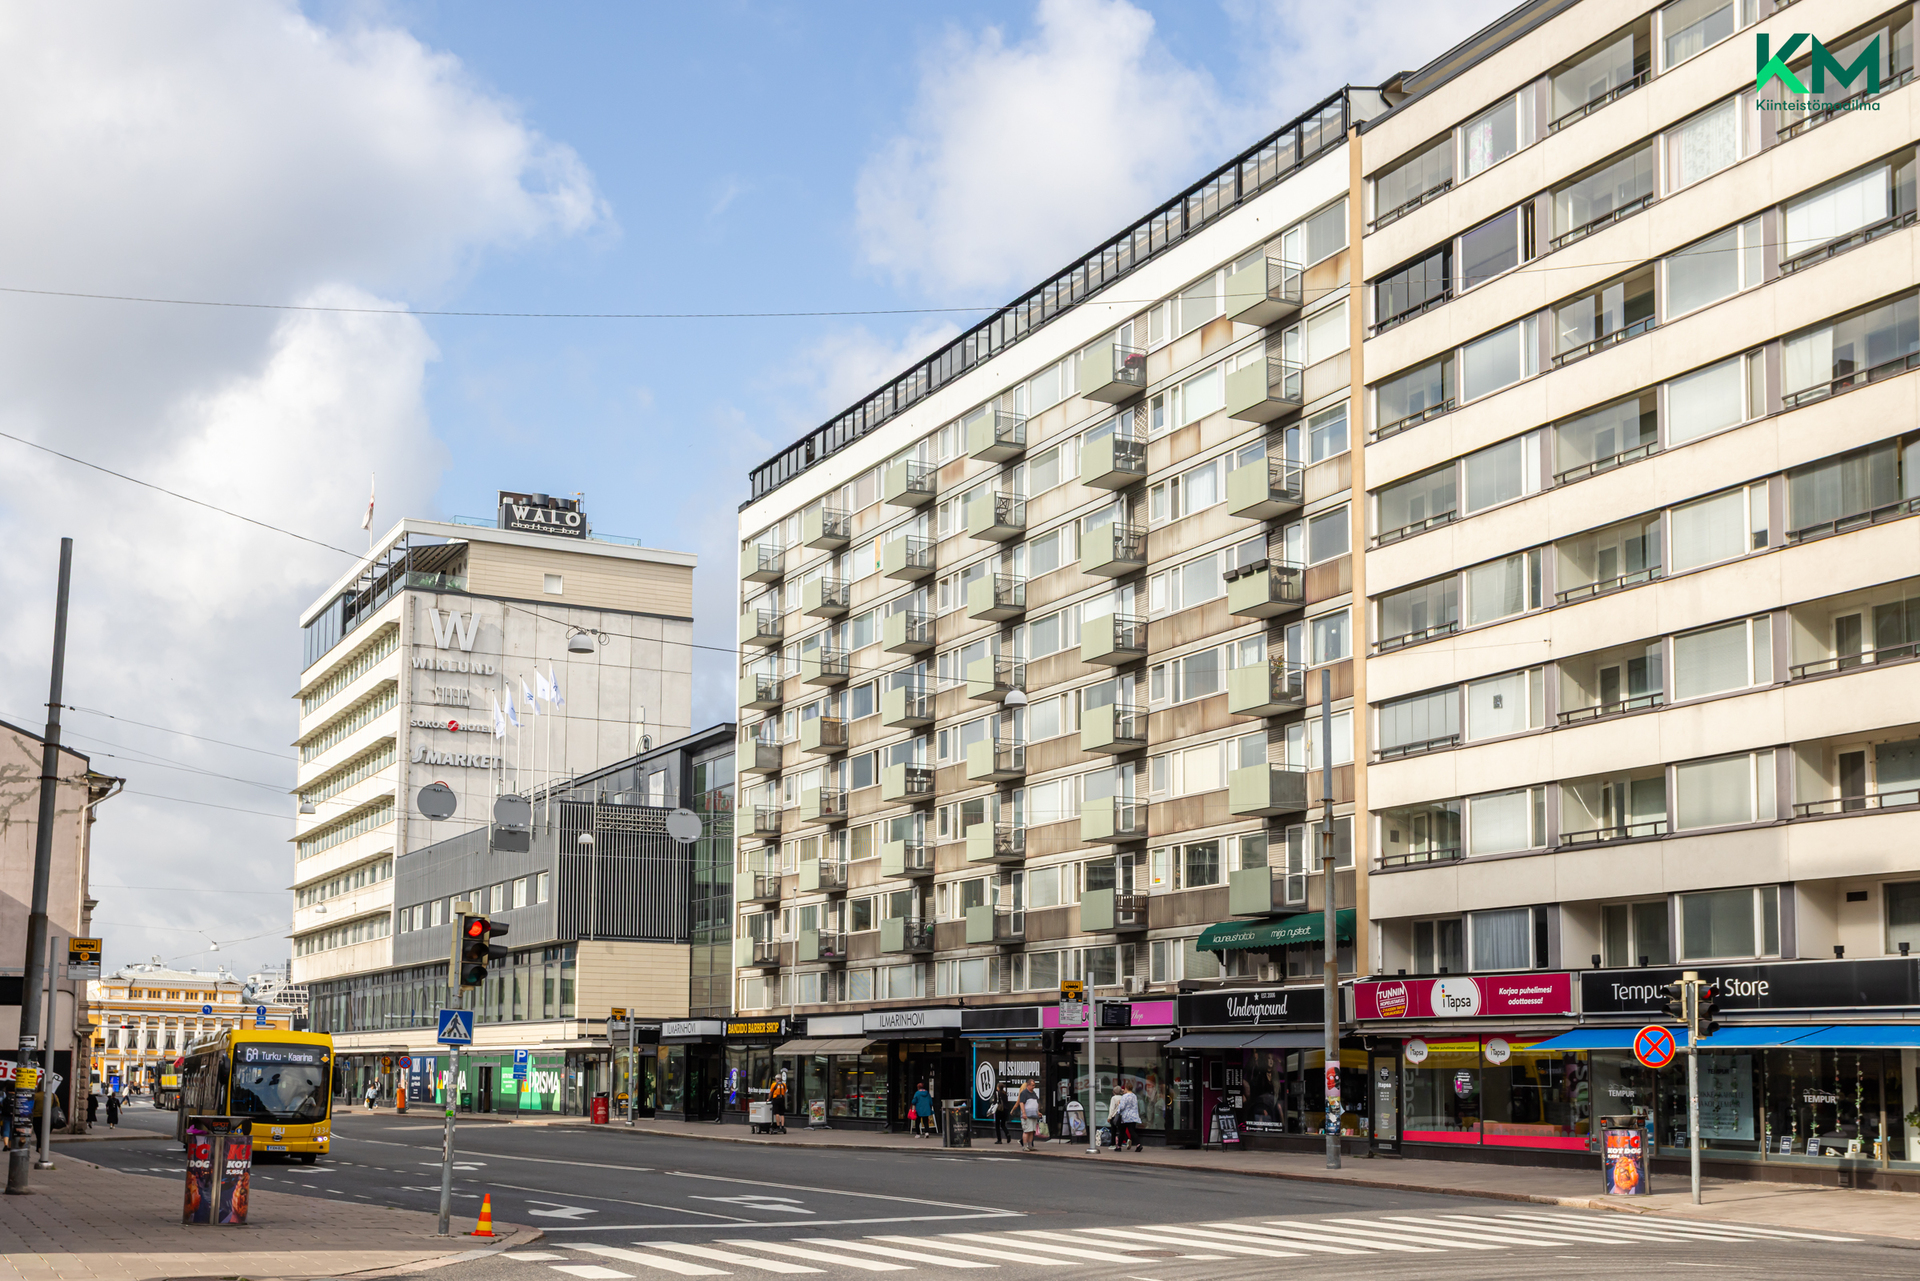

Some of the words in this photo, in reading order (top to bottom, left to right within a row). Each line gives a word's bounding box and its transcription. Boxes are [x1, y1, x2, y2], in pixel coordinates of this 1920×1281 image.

[512, 504, 581, 527] WALO
[511, 521, 556, 533] rooftop
[562, 527, 580, 535] bar
[429, 608, 481, 651] W
[412, 656, 495, 676] WIKLUND
[410, 719, 446, 730] SOKOS
[460, 723, 497, 734] HOTEL
[1213, 932, 1255, 943] kauneushoitola
[1270, 929, 1286, 940] mirja
[1287, 926, 1311, 939] nystedt
[1377, 987, 1405, 999] TUNNIN
[1499, 987, 1518, 996] Korjaa
[1519, 985, 1552, 995] puhelimesi
[1724, 979, 1769, 997] Store
[1508, 997, 1543, 1005] odottaessa!
[1227, 994, 1288, 1025] Underground
[880, 1013, 925, 1027] ILMARINHOVI
[666, 1023, 696, 1034] ILMARINHOVI
[728, 1023, 747, 1034] BANDIDO
[748, 1023, 766, 1033] BARBER
[766, 1022, 779, 1033] SHOP
[246, 1048, 259, 1062] 6A
[262, 1052, 281, 1060] Turku
[288, 1053, 313, 1062] Kaarina
[516, 1050, 526, 1062] P
[999, 1061, 1040, 1076] PUSSIKAUPPA
[529, 1071, 560, 1094] PRISMA
[1803, 1095, 1837, 1104] TEMPUR
[1607, 1136, 1641, 1148] KFC
